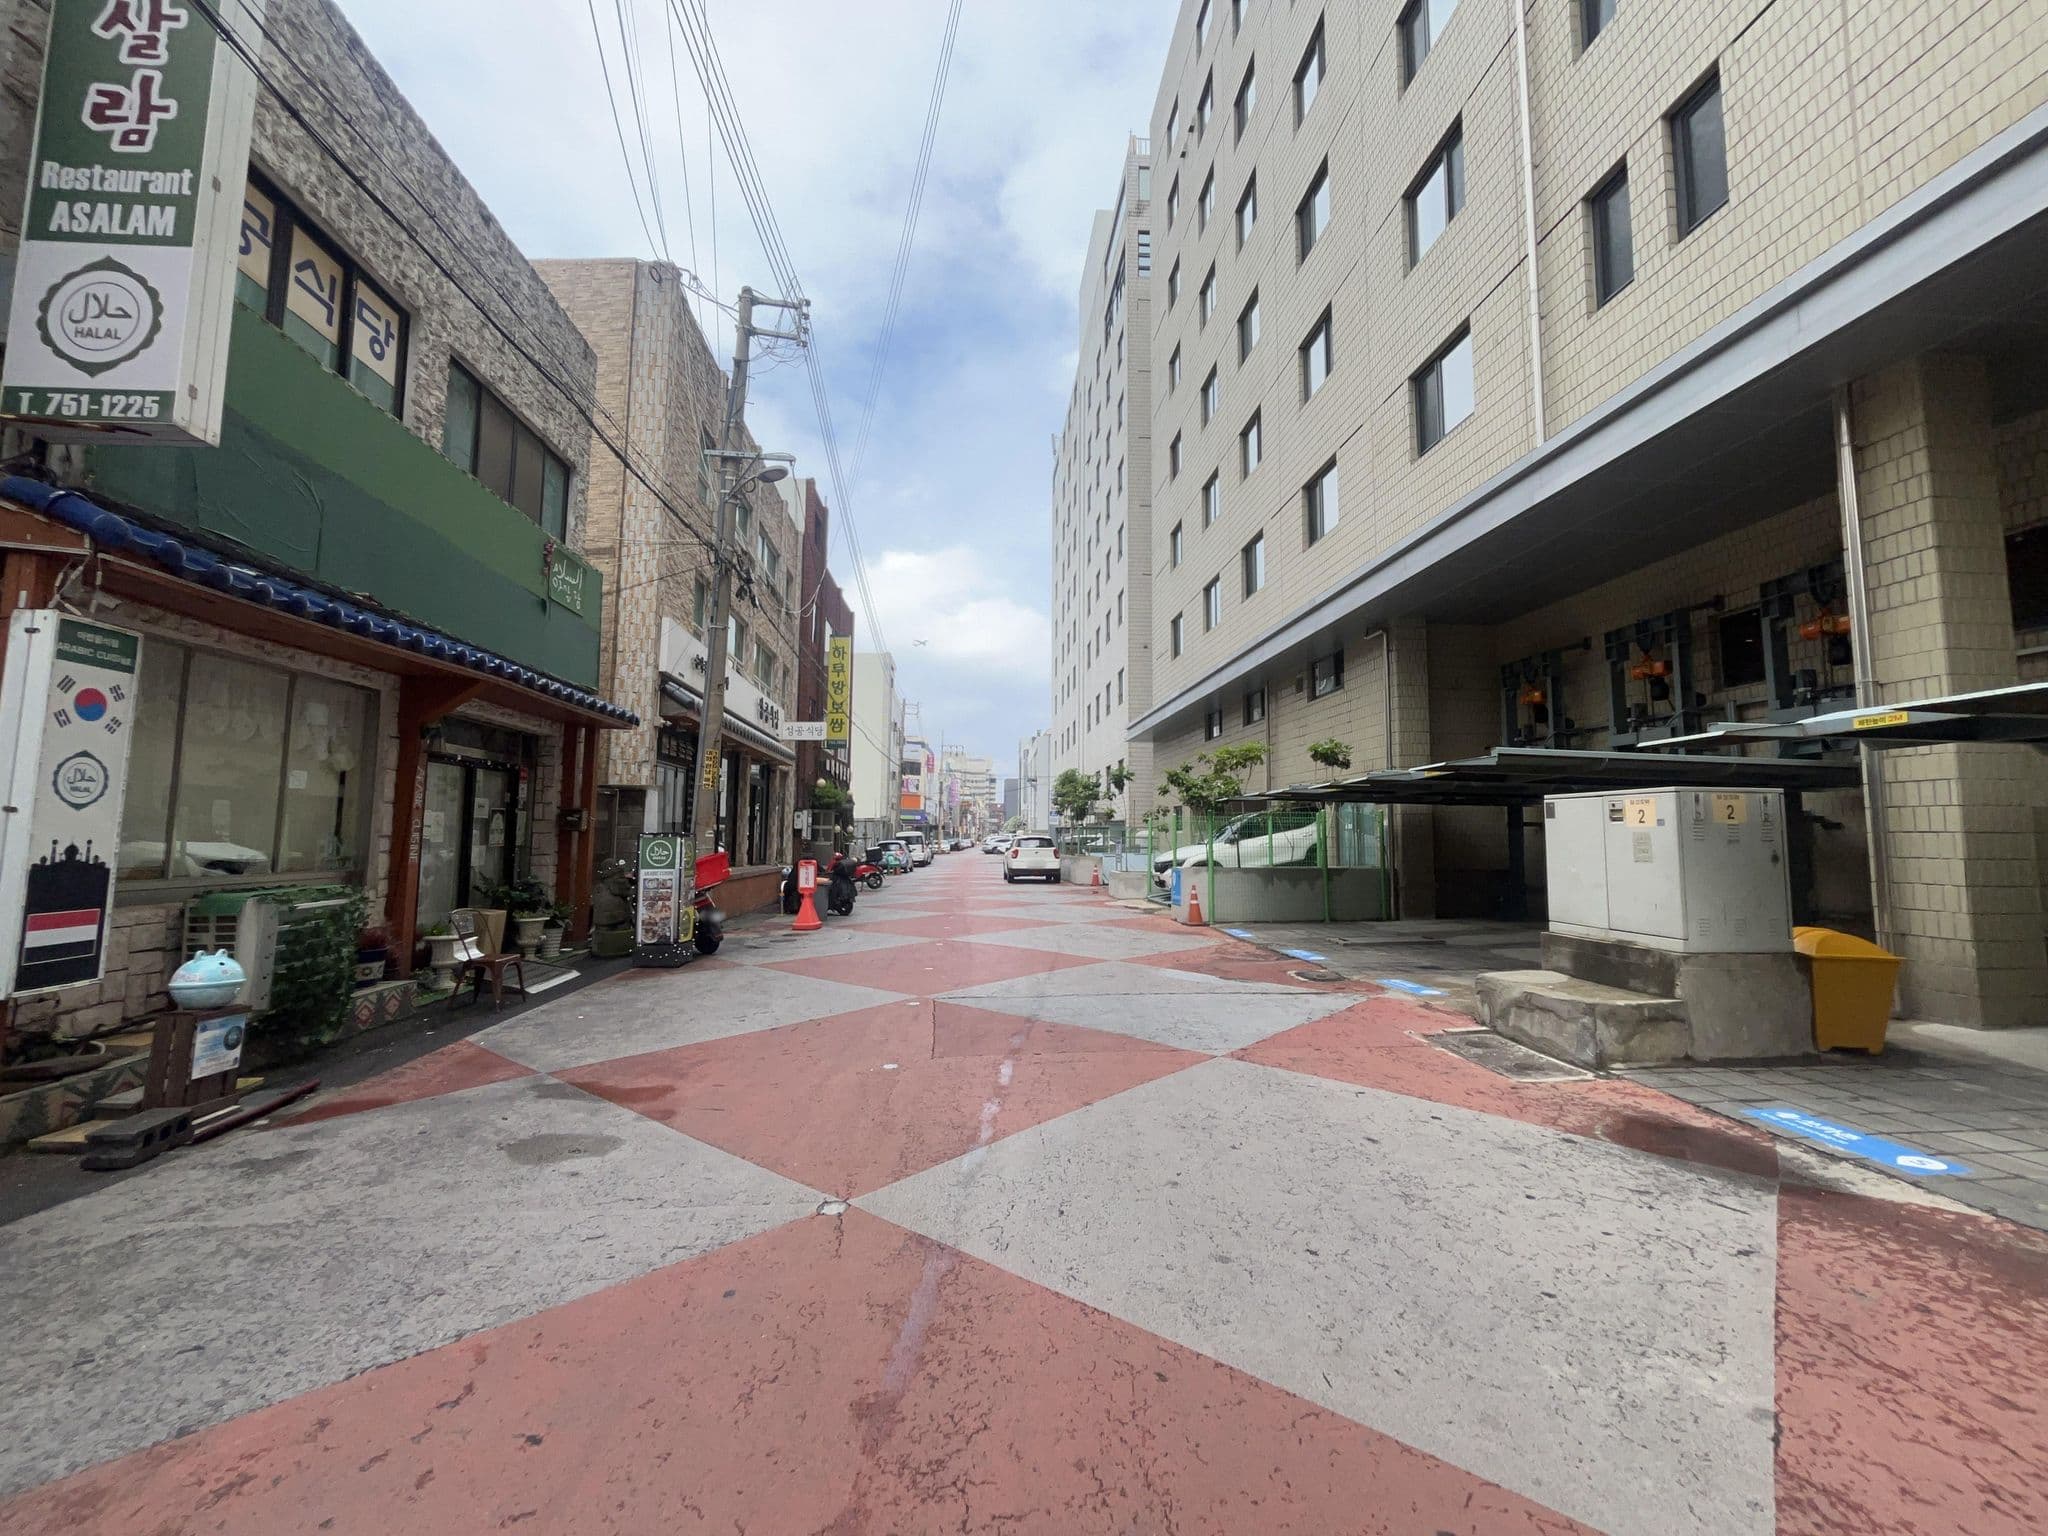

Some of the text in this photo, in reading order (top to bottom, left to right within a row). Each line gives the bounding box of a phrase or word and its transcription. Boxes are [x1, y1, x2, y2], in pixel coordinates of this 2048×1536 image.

[41, 161, 192, 196] Restaurant
[49, 202, 176, 237] ASALAM
[68, 292, 132, 324] حلال
[74, 326, 122, 341] HALAL
[18, 392, 160, 418] T. 751-1225
[784, 726, 824, 737] 성공식당
[1638, 809, 1646, 824] 2
[1726, 804, 1735, 820] 2
